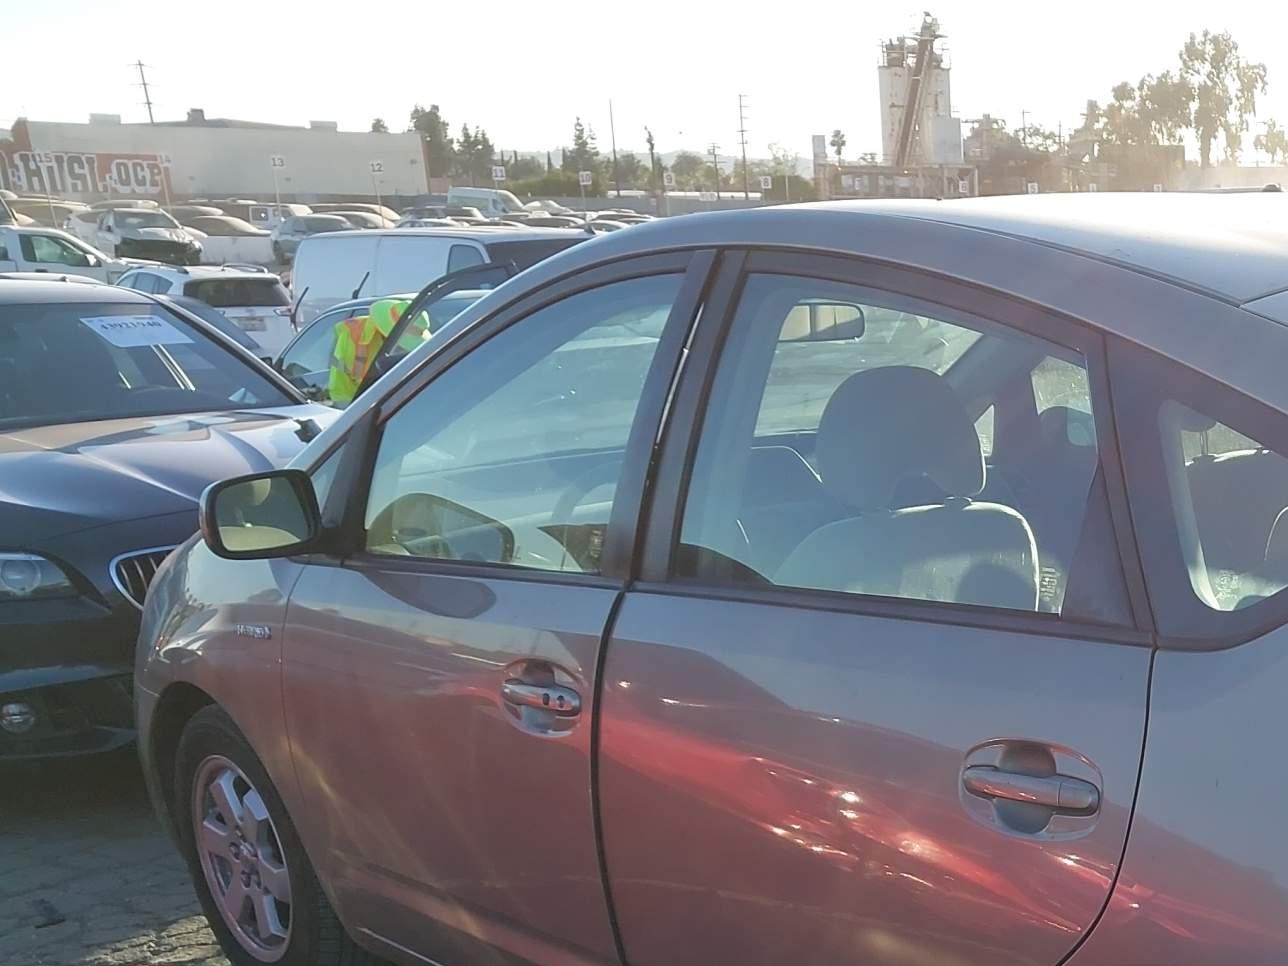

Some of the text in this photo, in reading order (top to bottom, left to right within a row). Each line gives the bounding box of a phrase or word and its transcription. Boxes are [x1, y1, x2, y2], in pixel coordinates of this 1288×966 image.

[271, 157, 285, 168] 13
[370, 162, 384, 172] 12
[665, 174, 673, 185] 9
